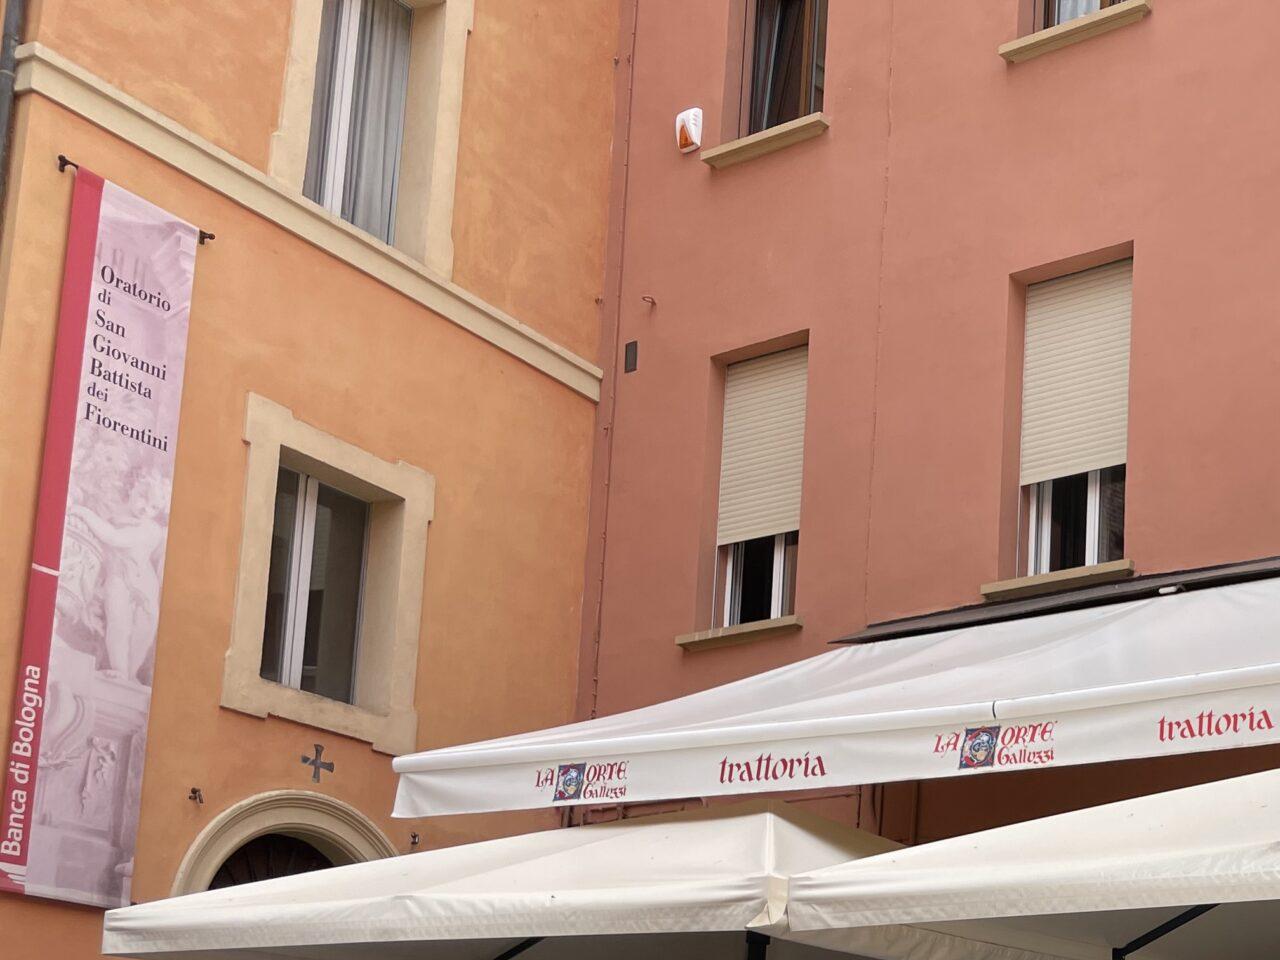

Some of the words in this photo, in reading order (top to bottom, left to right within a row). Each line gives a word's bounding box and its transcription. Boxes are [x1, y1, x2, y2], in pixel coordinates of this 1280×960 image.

[98, 289, 111, 305] di
[101, 265, 171, 312] Oratorio
[95, 309, 126, 338] San
[93, 334, 167, 381] Giovanni
[87, 382, 108, 402] dei
[90, 358, 152, 400] Battista
[84, 402, 168, 452] Fiorentini
[12, 665, 42, 758] Bologna
[1157, 706, 1275, 743] trattoria
[933, 732, 960, 758] LA
[997, 745, 1055, 766] Galluzzi
[10, 761, 29, 784] di
[535, 768, 556, 792] LA
[718, 751, 827, 784] trattoria
[1, 791, 27, 856] Banca
